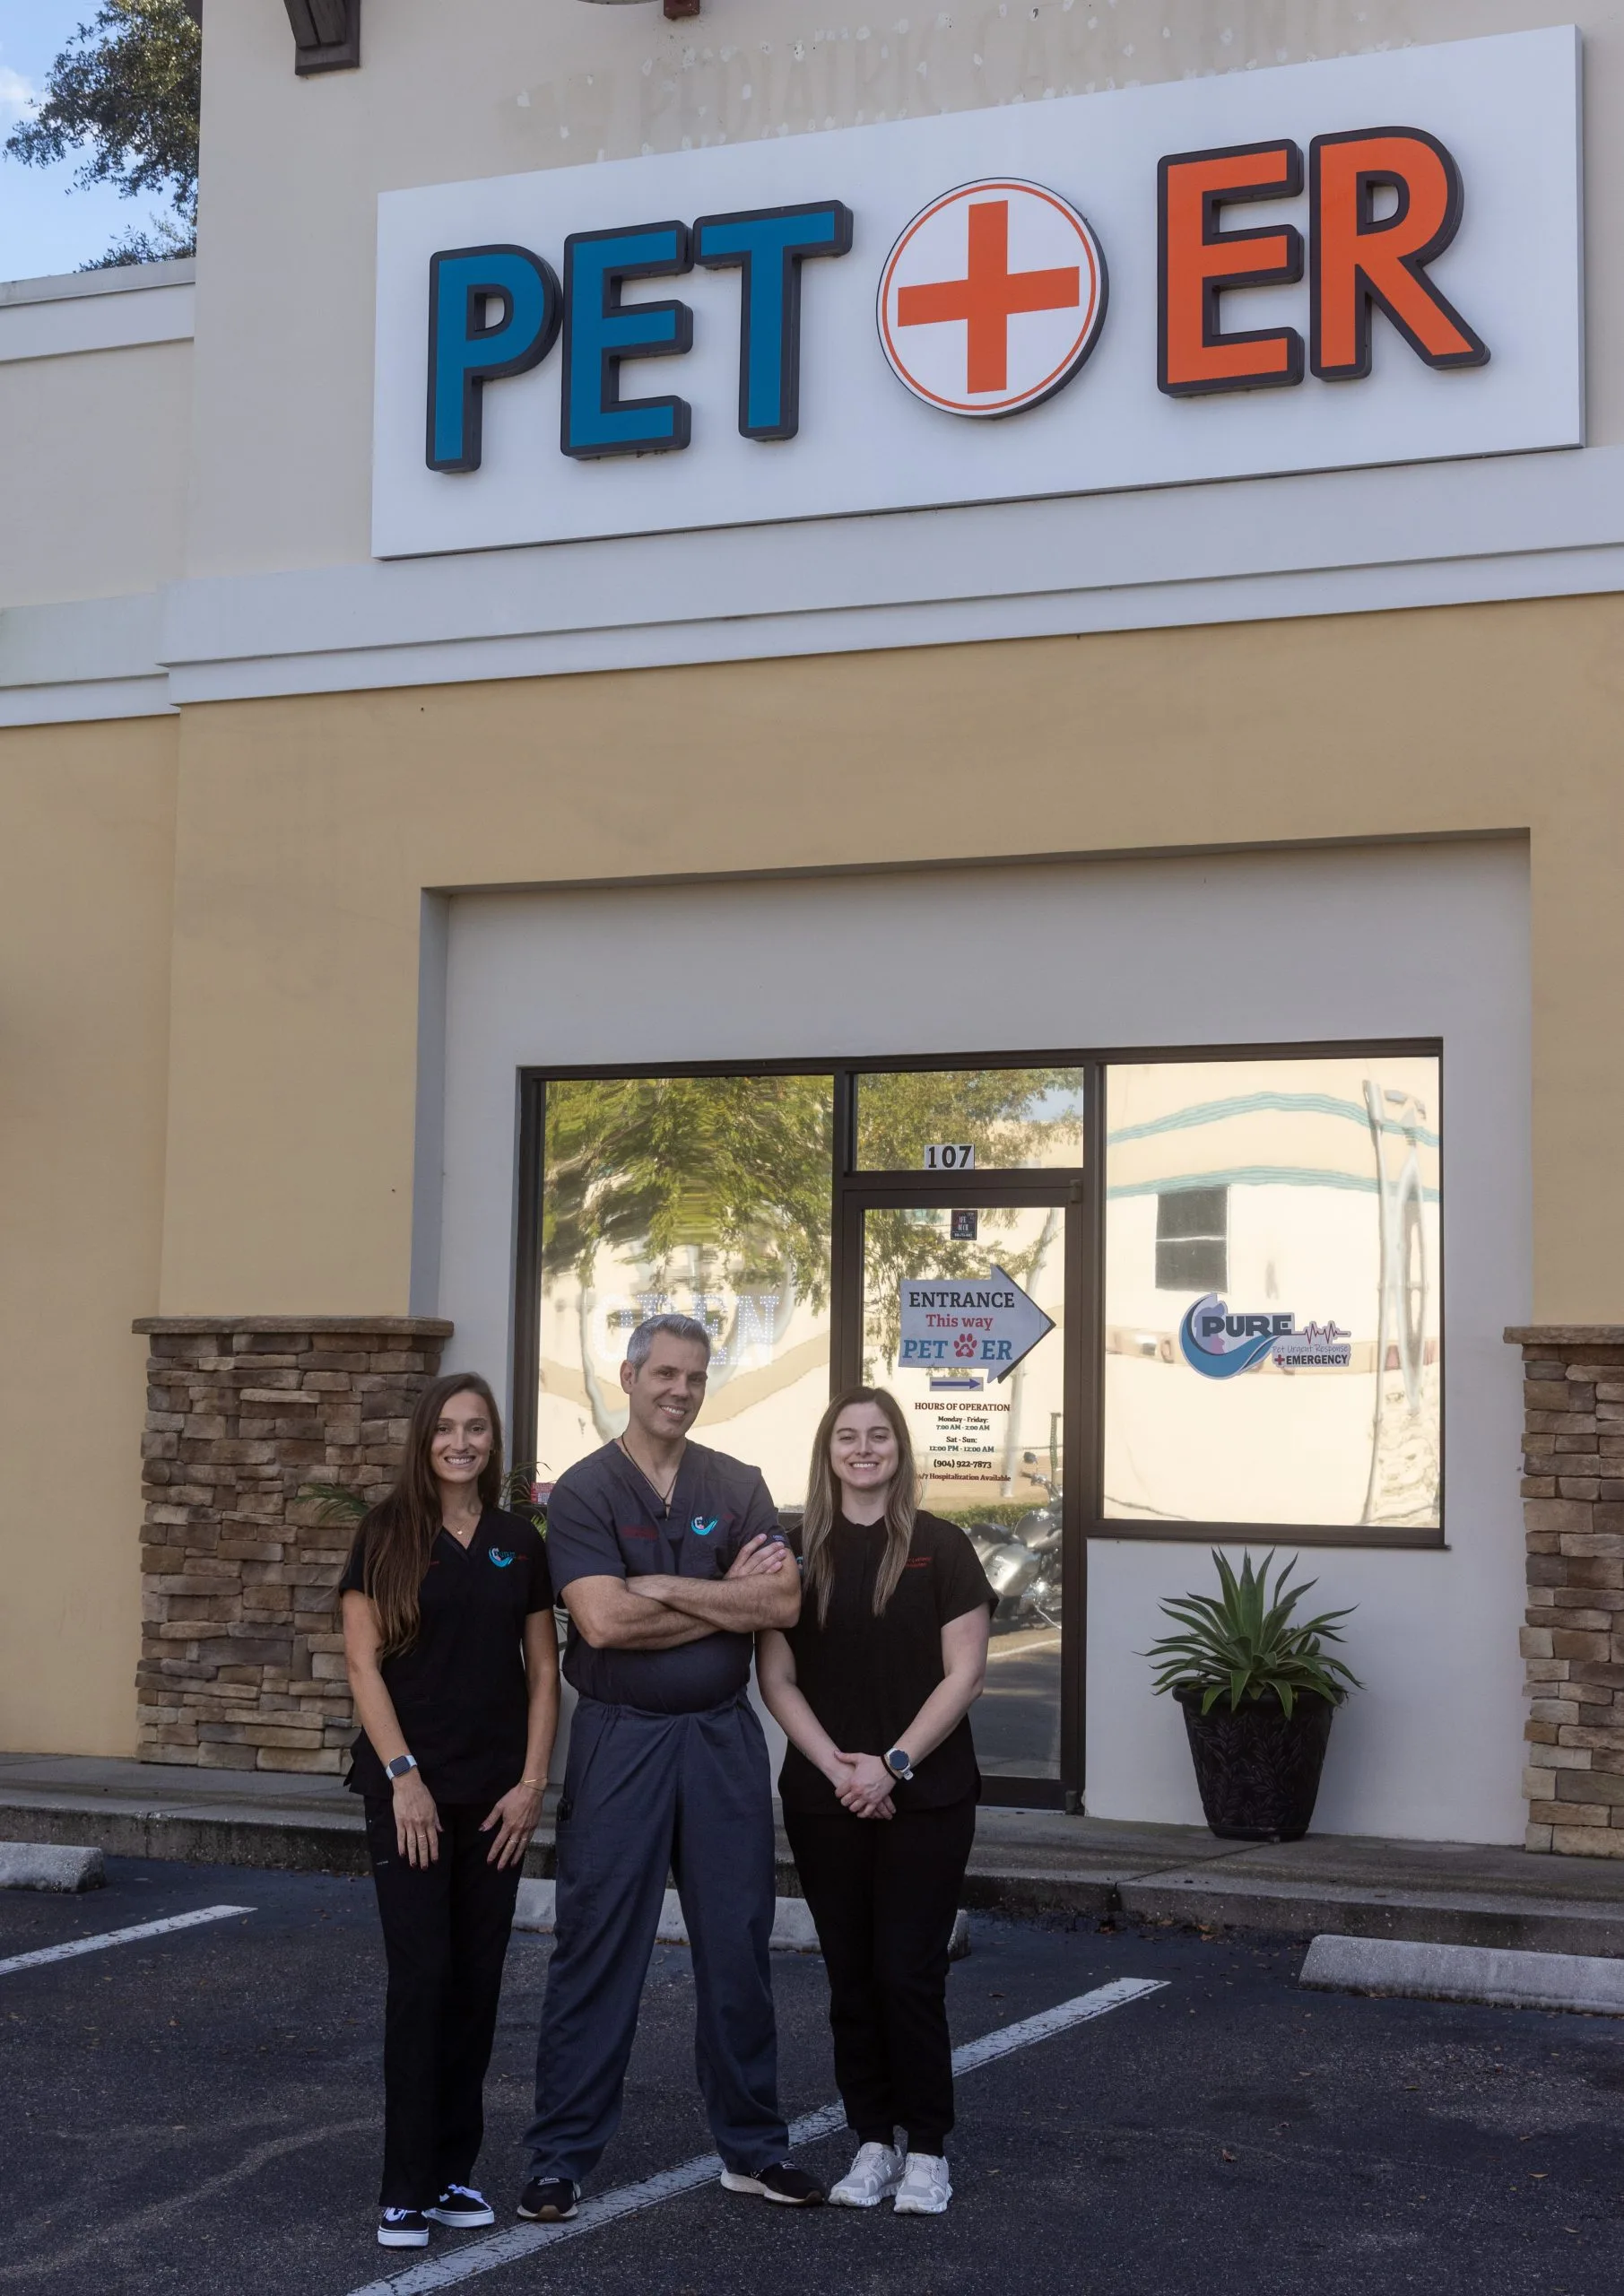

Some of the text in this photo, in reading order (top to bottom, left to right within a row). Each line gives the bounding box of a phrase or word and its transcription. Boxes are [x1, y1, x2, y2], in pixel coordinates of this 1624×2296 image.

[426, 126, 1490, 473] PET ER
[927, 1145, 972, 1169] 107
[908, 1292, 1015, 1309] ENTRANCE
[925, 1314, 994, 1331] This way
[1202, 1315, 1292, 1339] PURE
[902, 1339, 1013, 1360] PET ER
[1287, 1345, 1313, 1354] Urgent
[1316, 1345, 1348, 1354] Response
[1286, 1354, 1348, 1365] EMERGENCY
[915, 1402, 1011, 1412] HOURS OF OPERATION
[967, 1416, 989, 1424] Friday:
[934, 1459, 992, 1468] (904) 922-7873
[929, 1473, 979, 1481] Hospitalization
[980, 1474, 1012, 1482] Available
